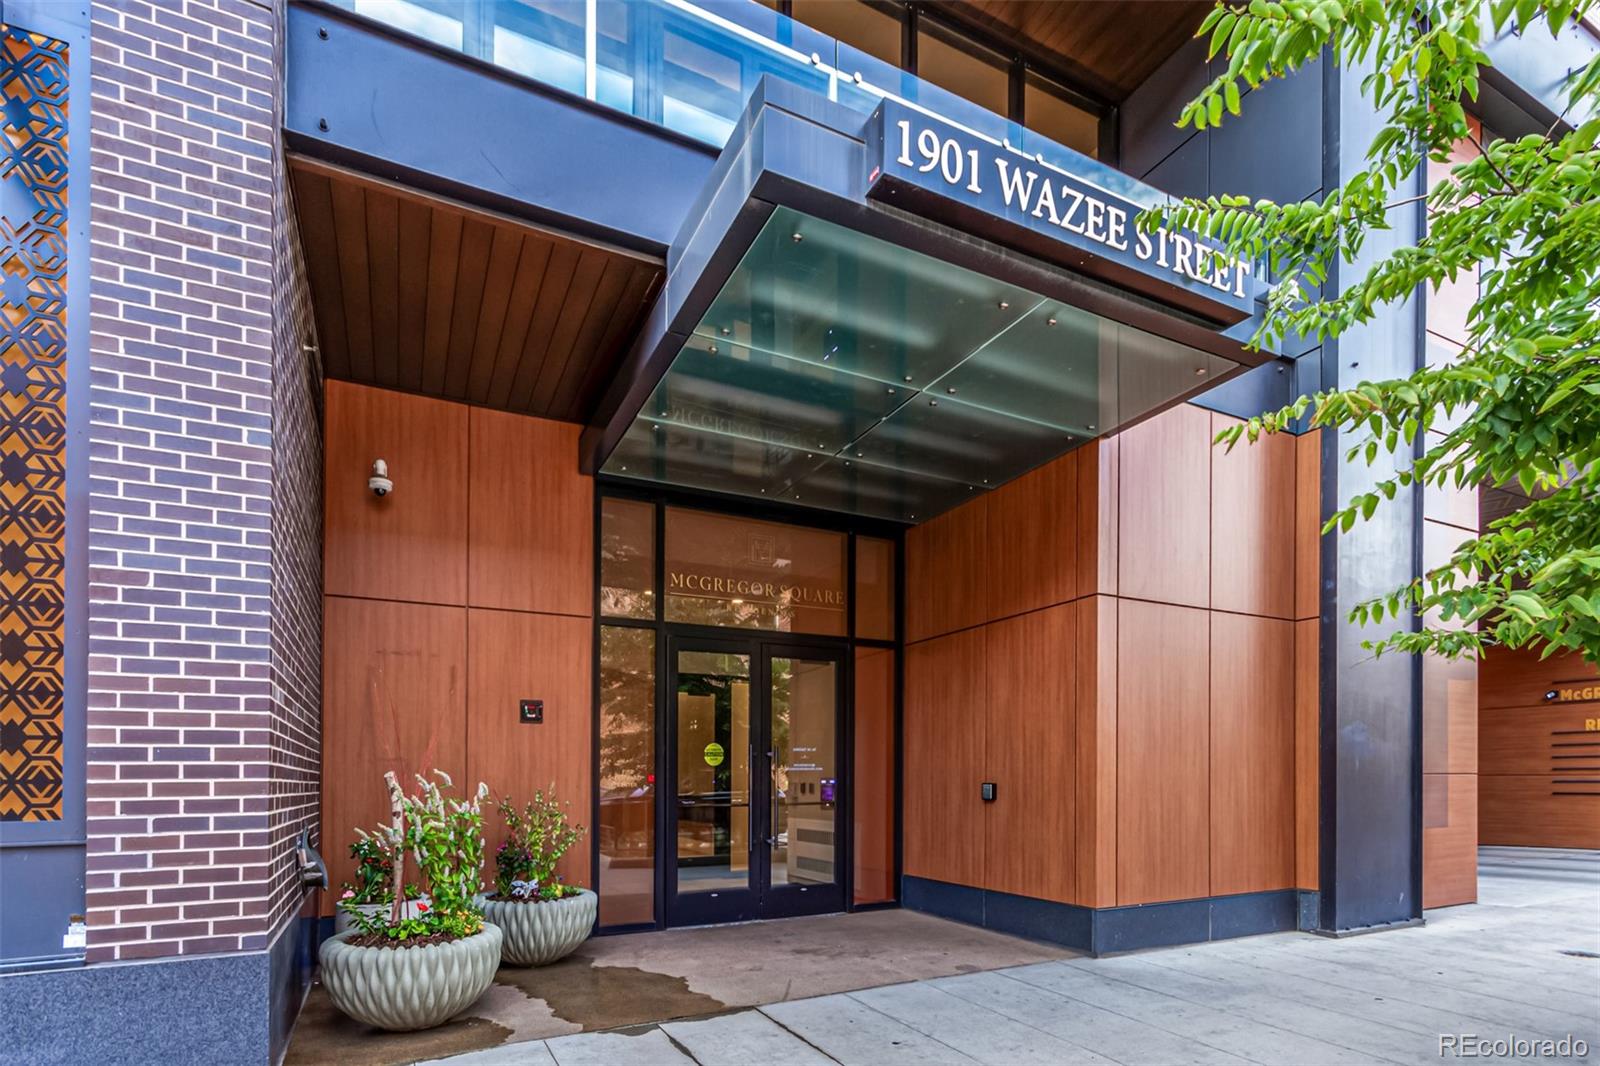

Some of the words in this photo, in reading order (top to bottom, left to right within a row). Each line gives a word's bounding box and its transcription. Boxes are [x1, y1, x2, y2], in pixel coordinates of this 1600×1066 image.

[896, 120, 983, 195] 1901
[994, 157, 1128, 252] WAZEE
[1134, 220, 1251, 299] STREET
[670, 572, 776, 597] MCGREGOR
